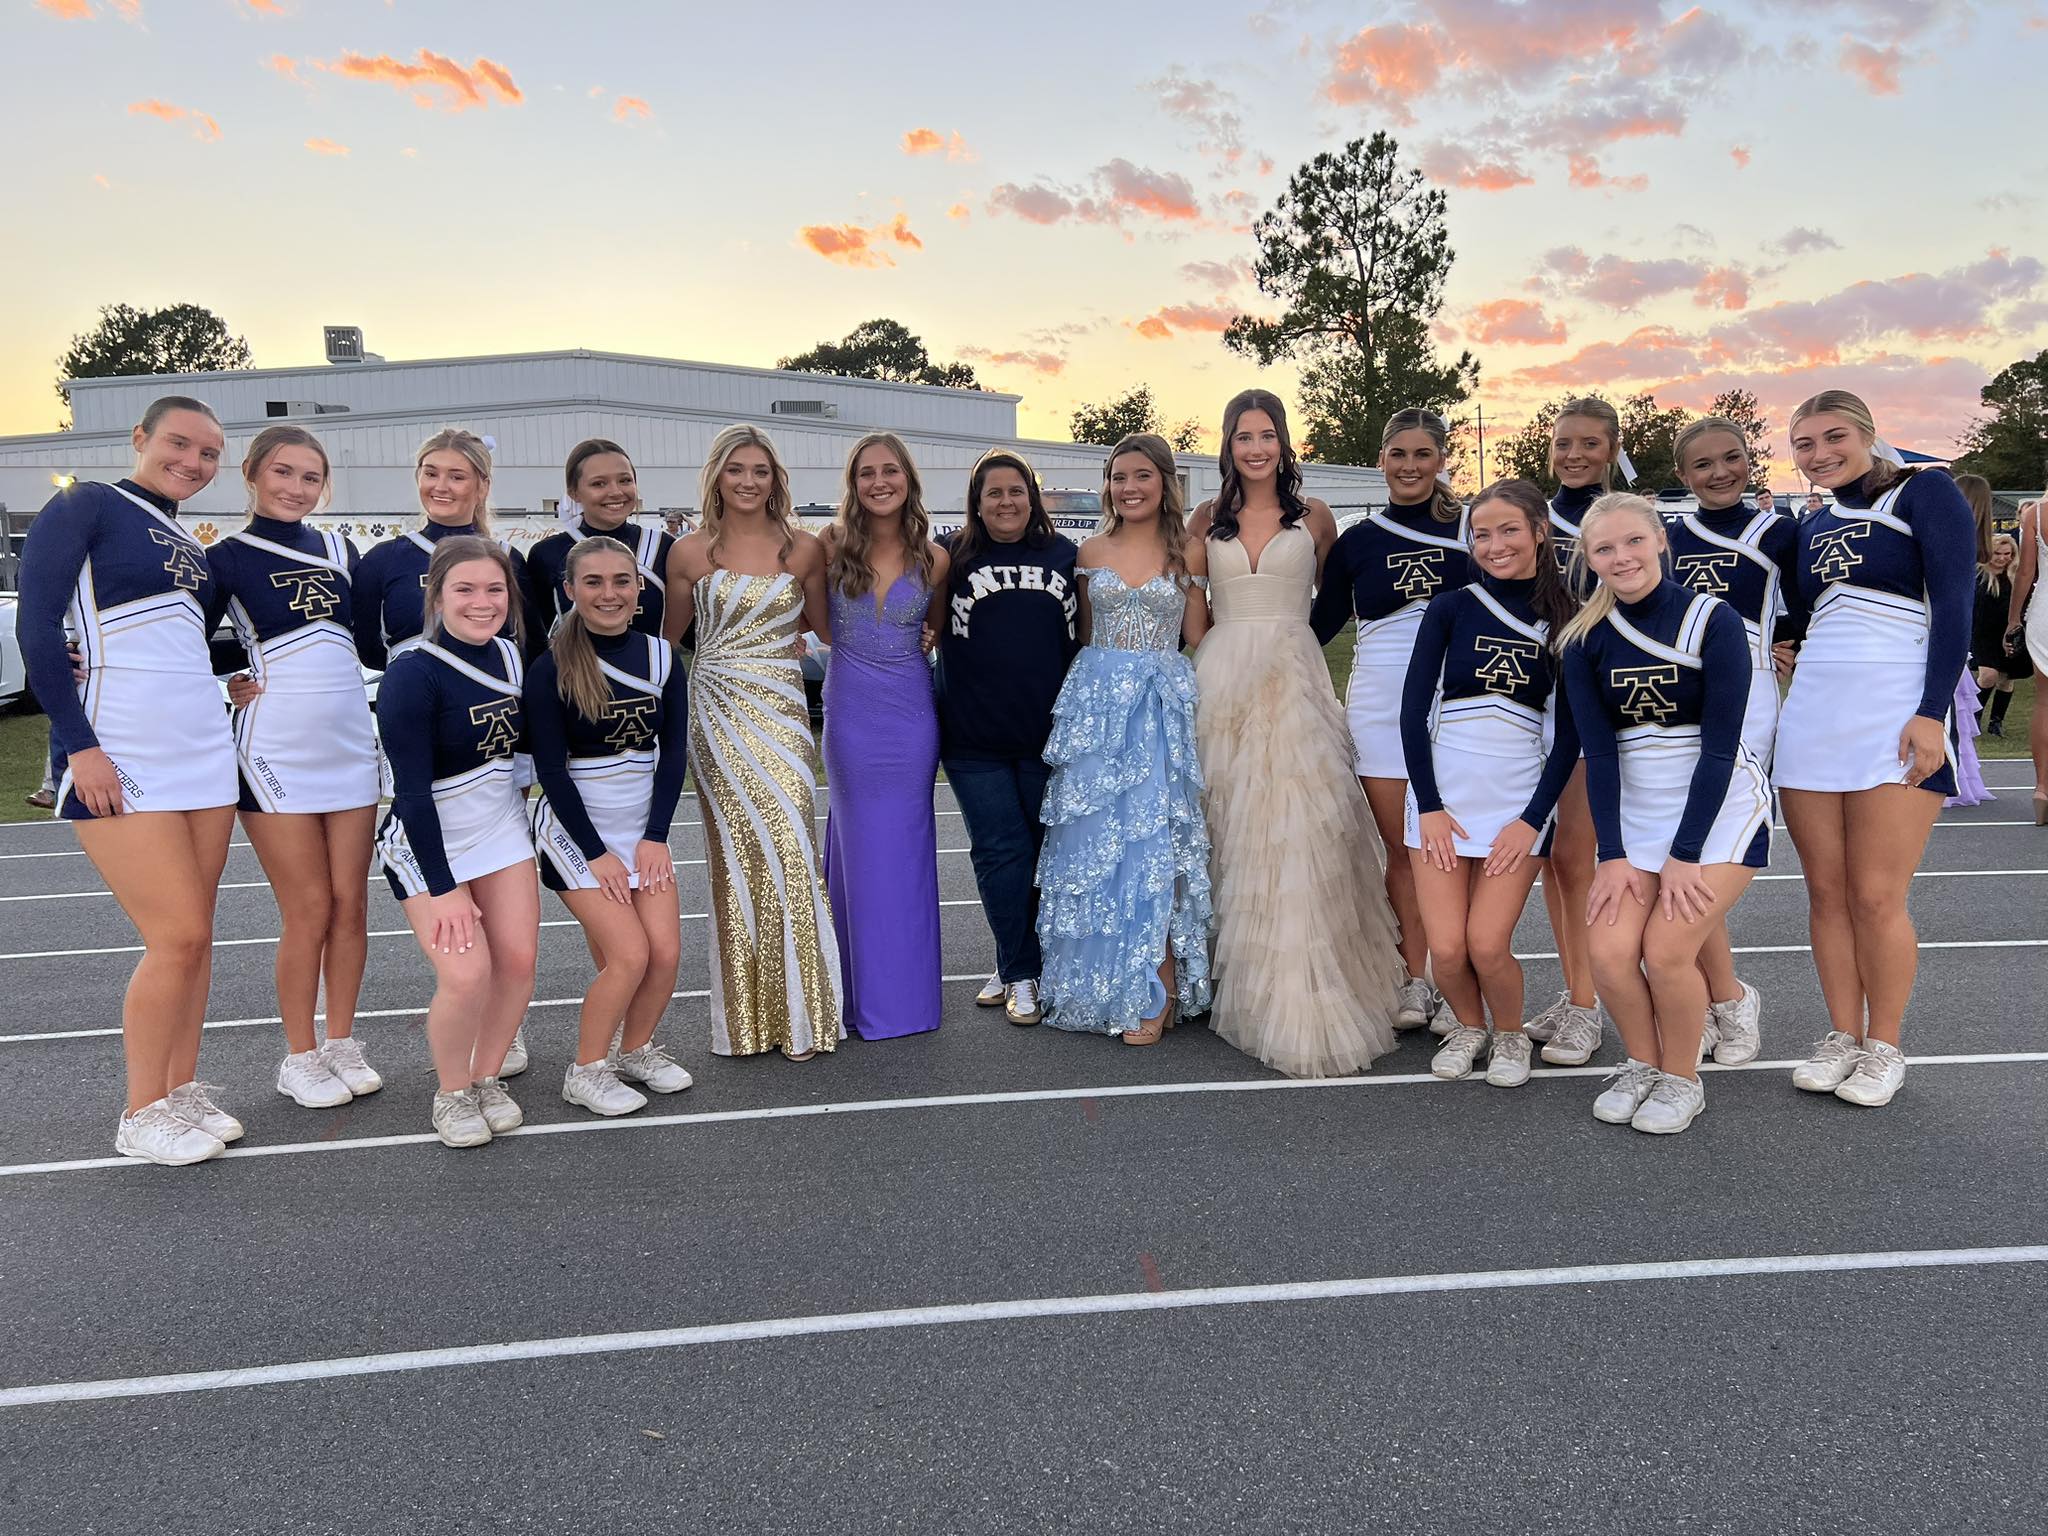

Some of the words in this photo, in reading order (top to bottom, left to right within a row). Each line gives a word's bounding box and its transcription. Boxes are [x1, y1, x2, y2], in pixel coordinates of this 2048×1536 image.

[1052, 519, 1075, 528] IRED
[148, 528, 208, 591] TA
[1387, 548, 1445, 599] TA
[1675, 552, 1739, 597] TA
[1809, 521, 1871, 583] TA
[269, 568, 341, 620] TA
[1474, 635, 1539, 694] TA
[1611, 664, 1679, 723] TA
[469, 696, 519, 760] TA
[601, 696, 657, 751] TA
[106, 756, 144, 799] NTHERS
[254, 756, 286, 800] PANTHERS
[554, 834, 587, 874] PANTHERS
